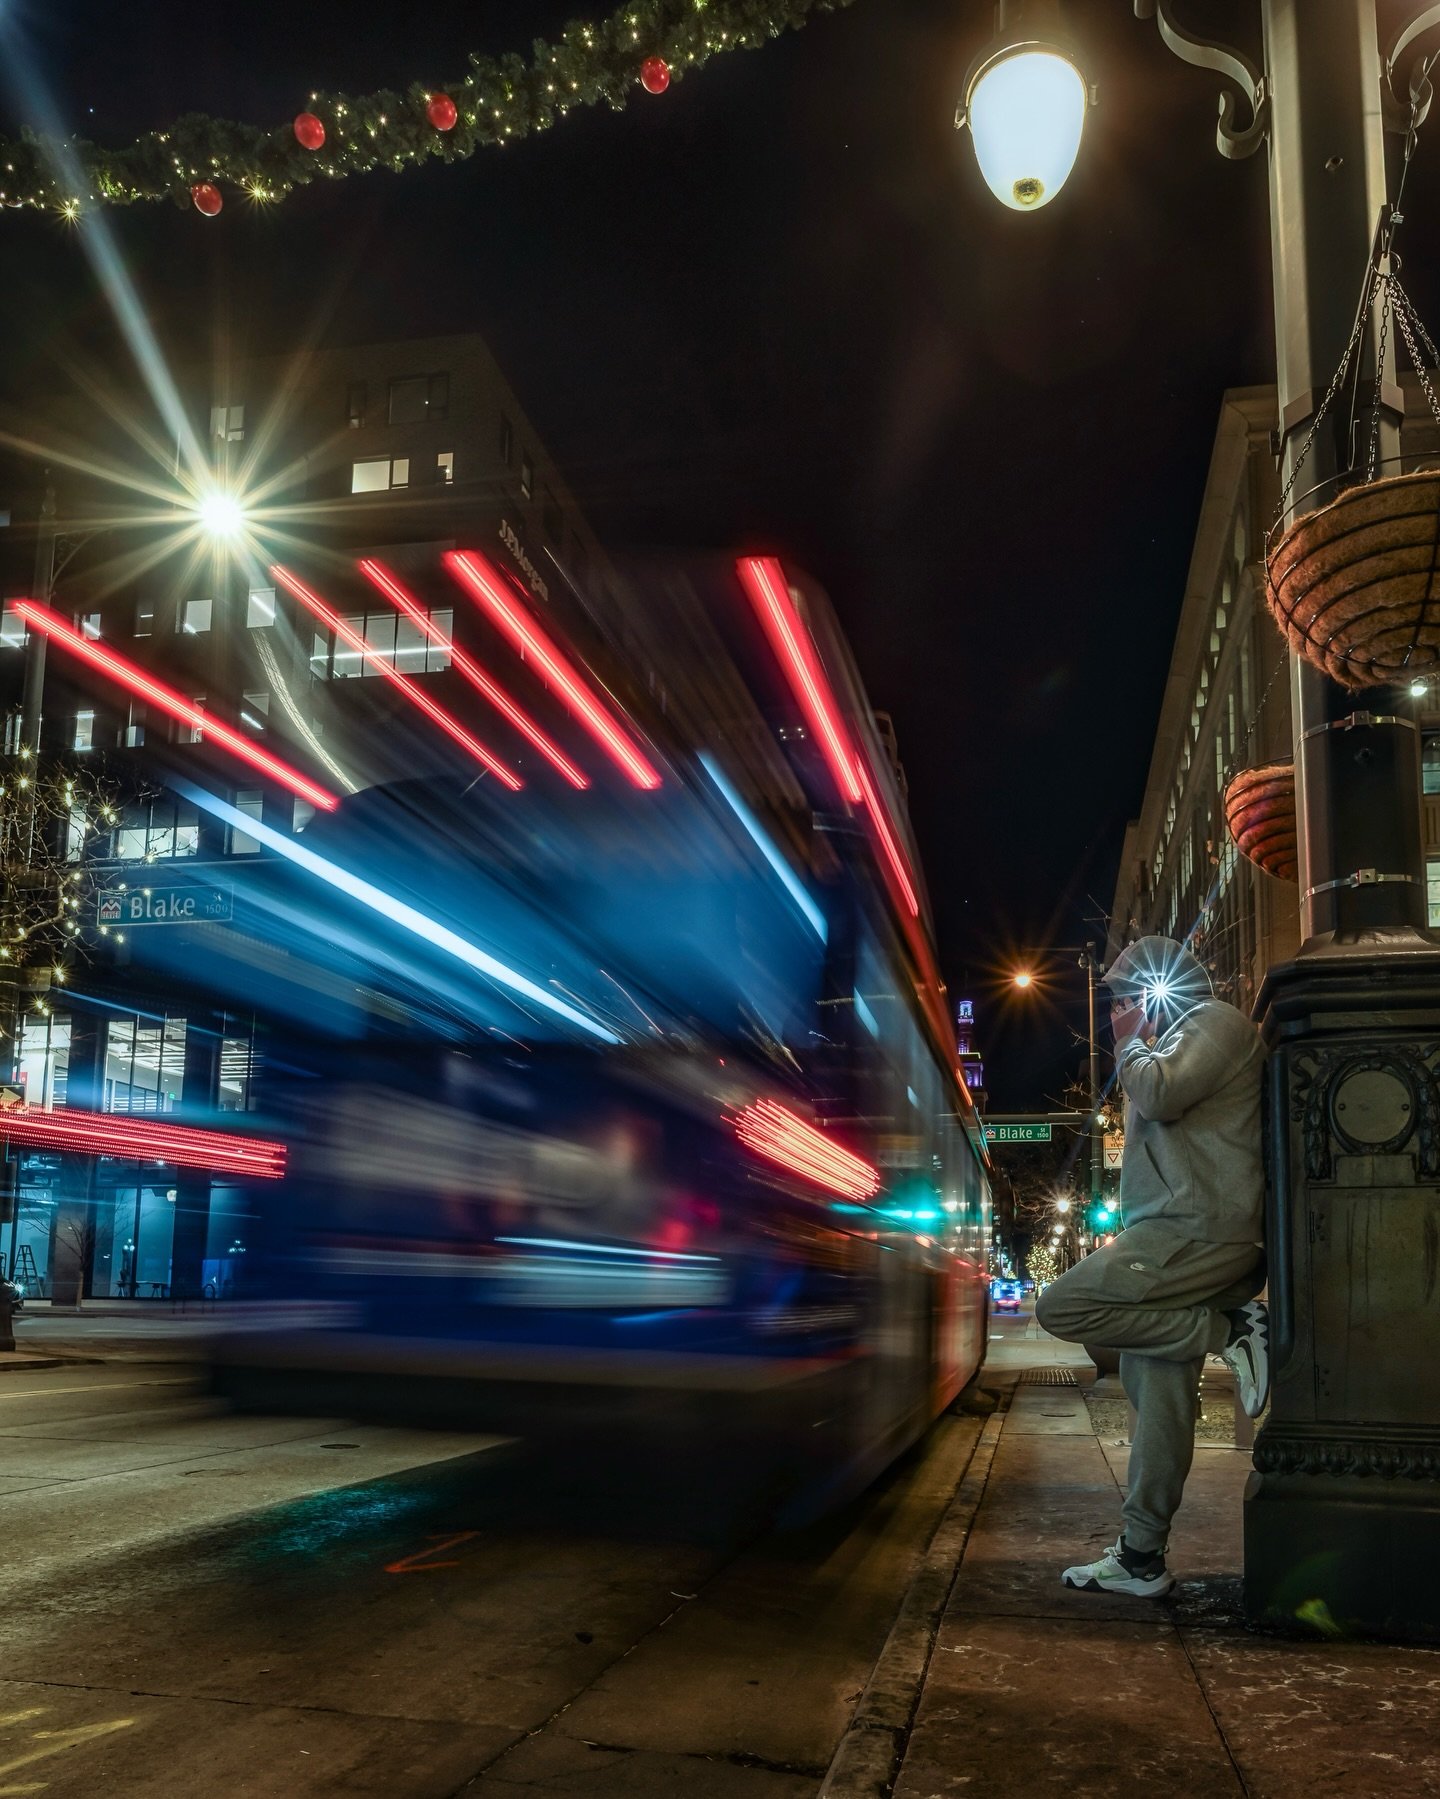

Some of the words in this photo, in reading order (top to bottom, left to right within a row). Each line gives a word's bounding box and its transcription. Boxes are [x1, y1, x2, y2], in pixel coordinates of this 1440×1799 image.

[131, 893, 195, 919] Blake
[205, 903, 228, 914] 1500
[999, 1127, 1033, 1139] Blake
